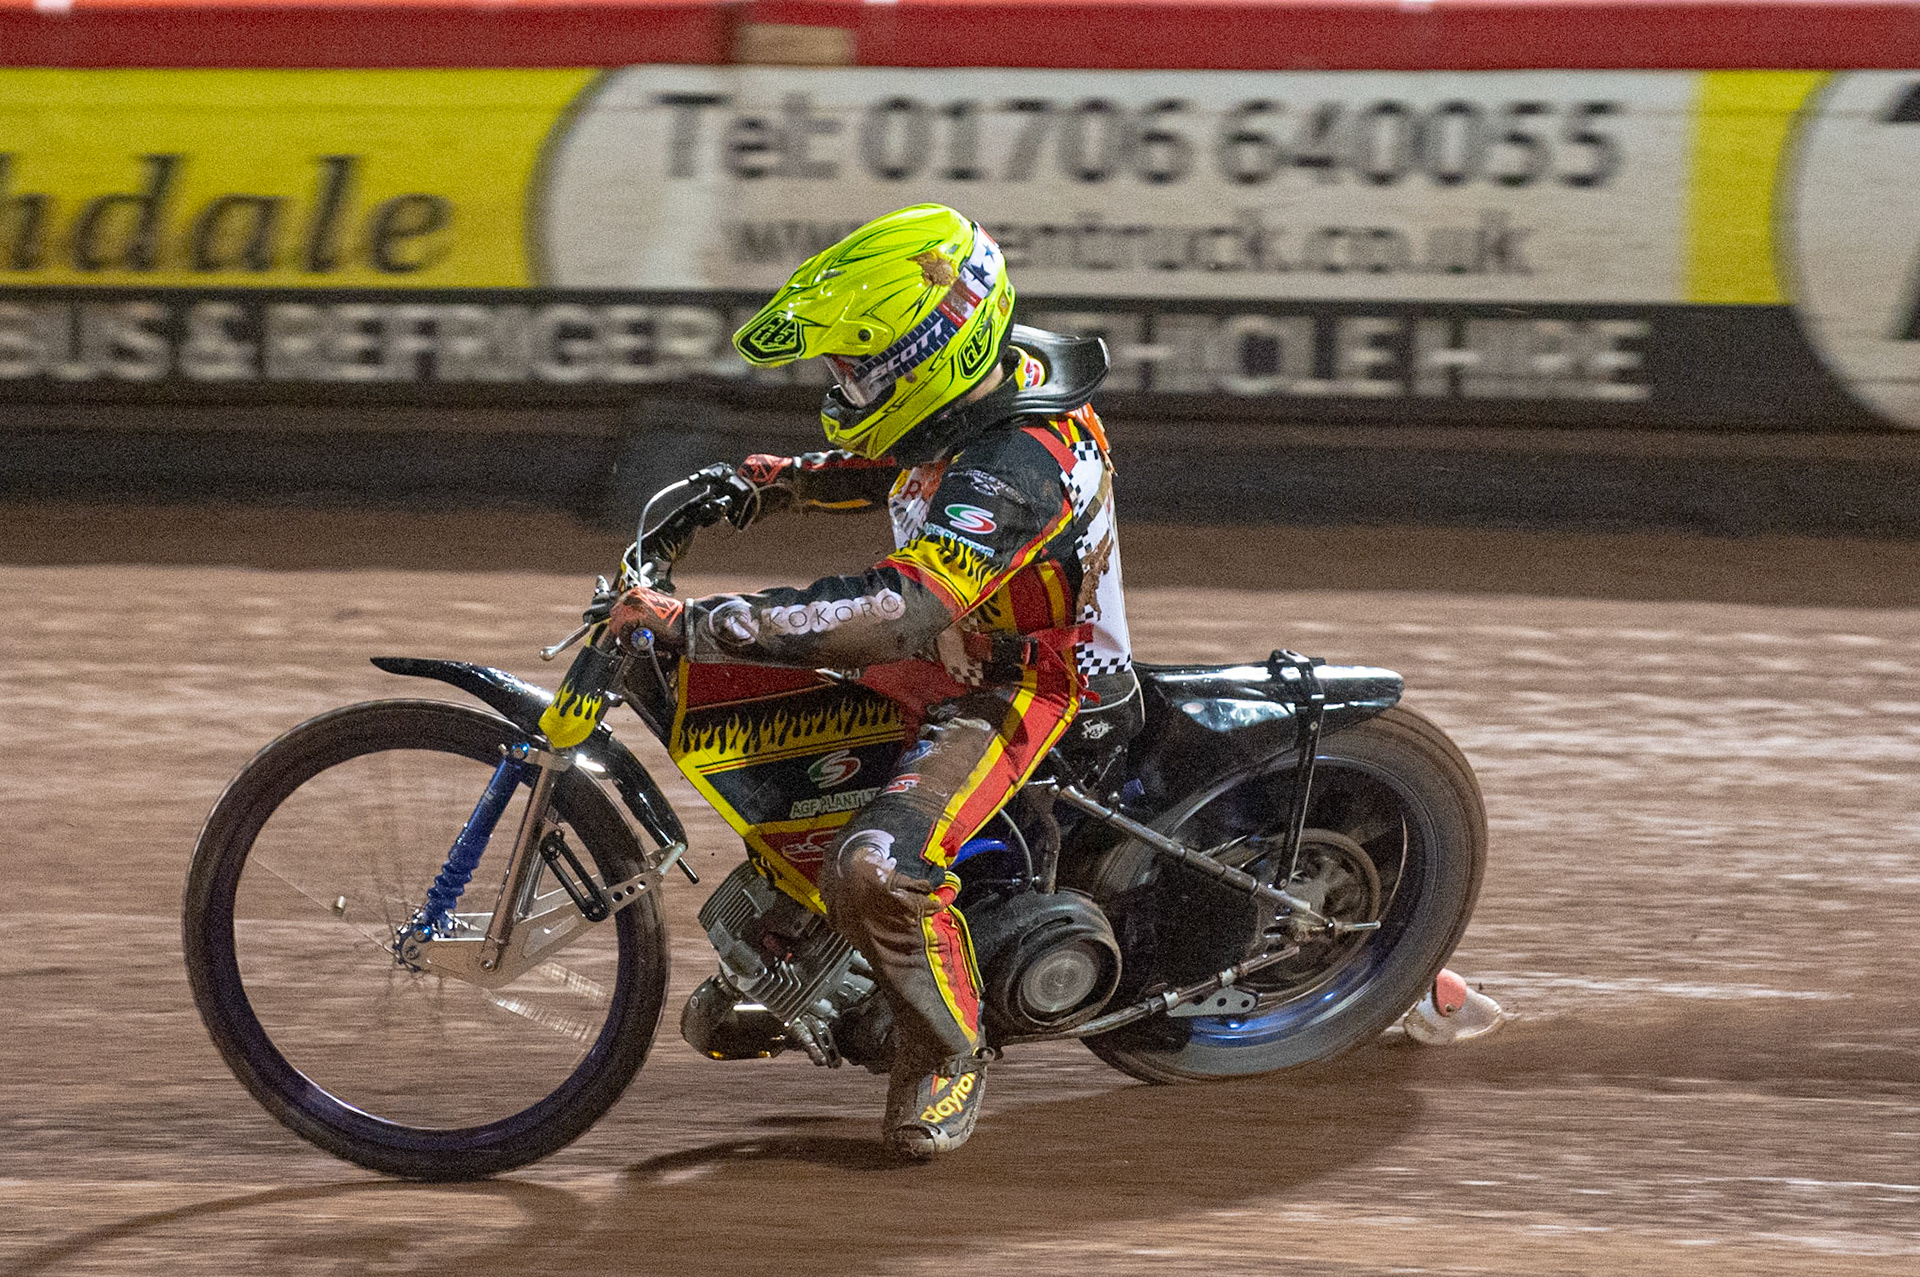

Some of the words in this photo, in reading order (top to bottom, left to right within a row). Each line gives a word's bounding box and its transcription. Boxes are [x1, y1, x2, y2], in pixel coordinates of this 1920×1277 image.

[1218, 97, 1628, 187] 640055
[868, 317, 944, 380] SCOTT
[768, 595, 900, 631] KOKORO
